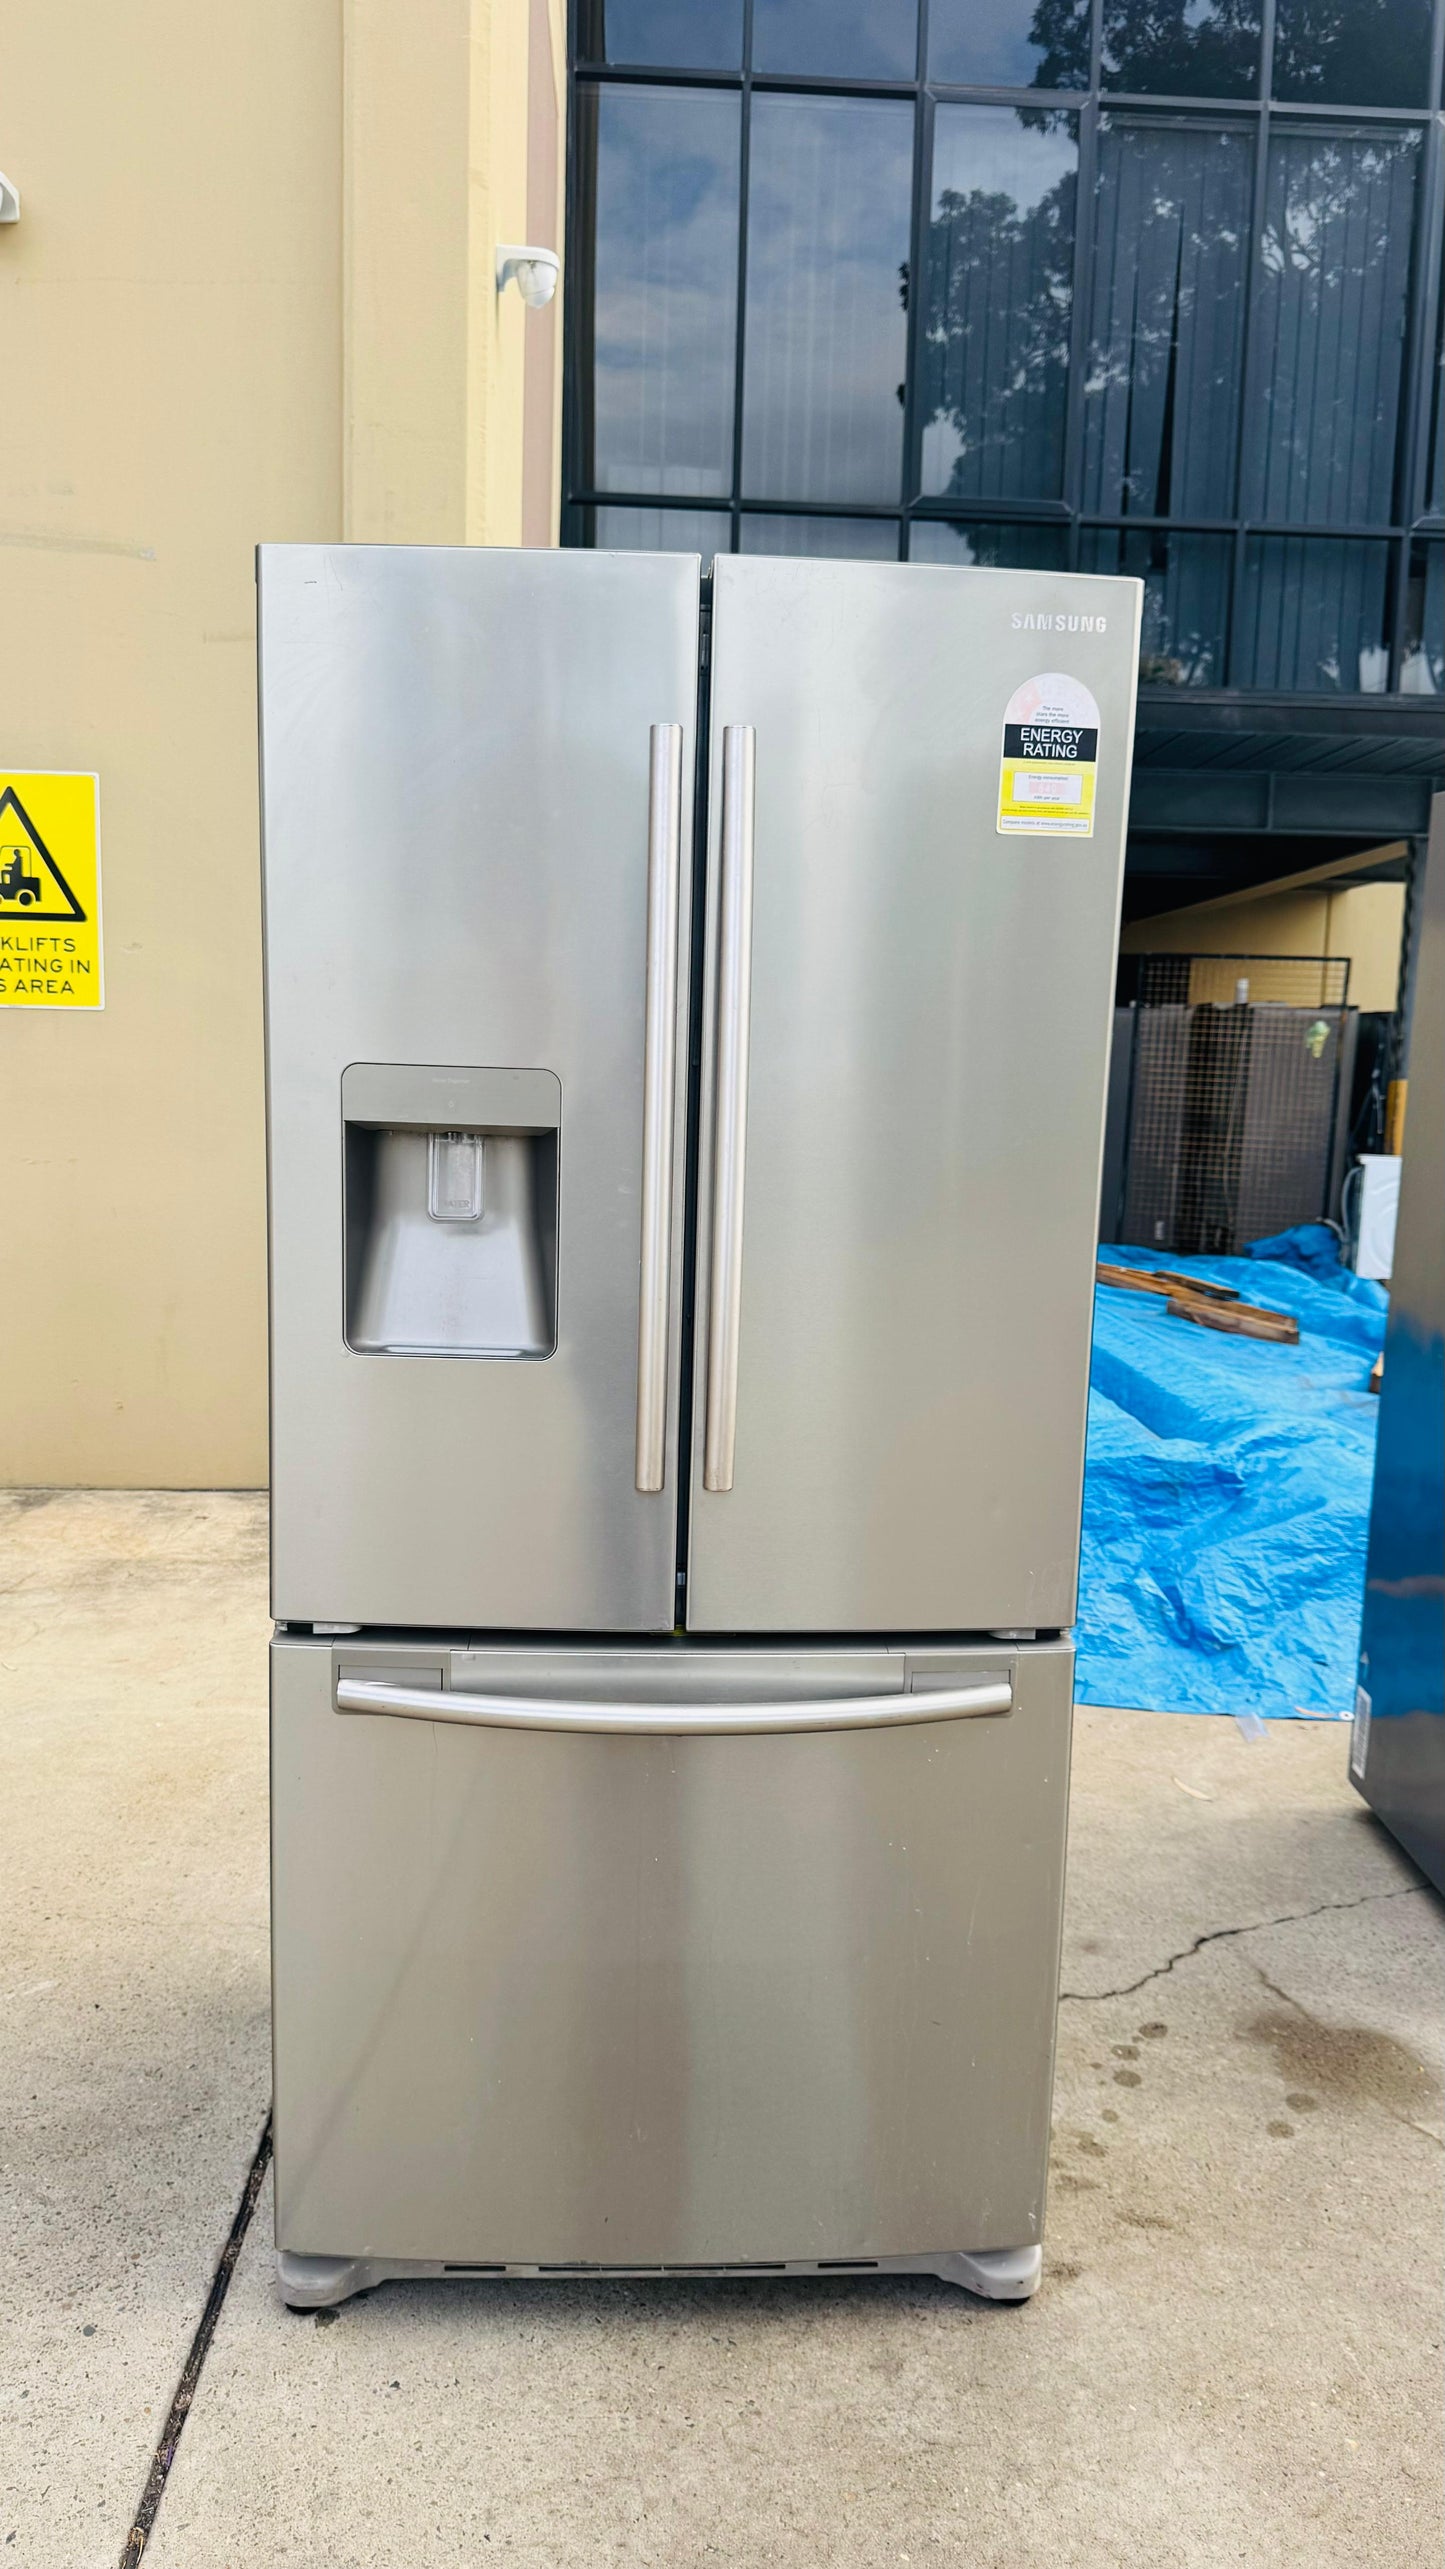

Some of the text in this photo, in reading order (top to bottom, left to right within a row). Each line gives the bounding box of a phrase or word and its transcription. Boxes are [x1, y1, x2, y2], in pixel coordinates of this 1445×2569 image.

[1011, 612, 1107, 633] SAMSUNG
[1020, 727, 1083, 744] ENERGY
[1023, 742, 1078, 758] RATING
[1, 936, 76, 952] KLIFTS
[0, 957, 91, 973] ATING IN
[14, 978, 75, 994] AREA
